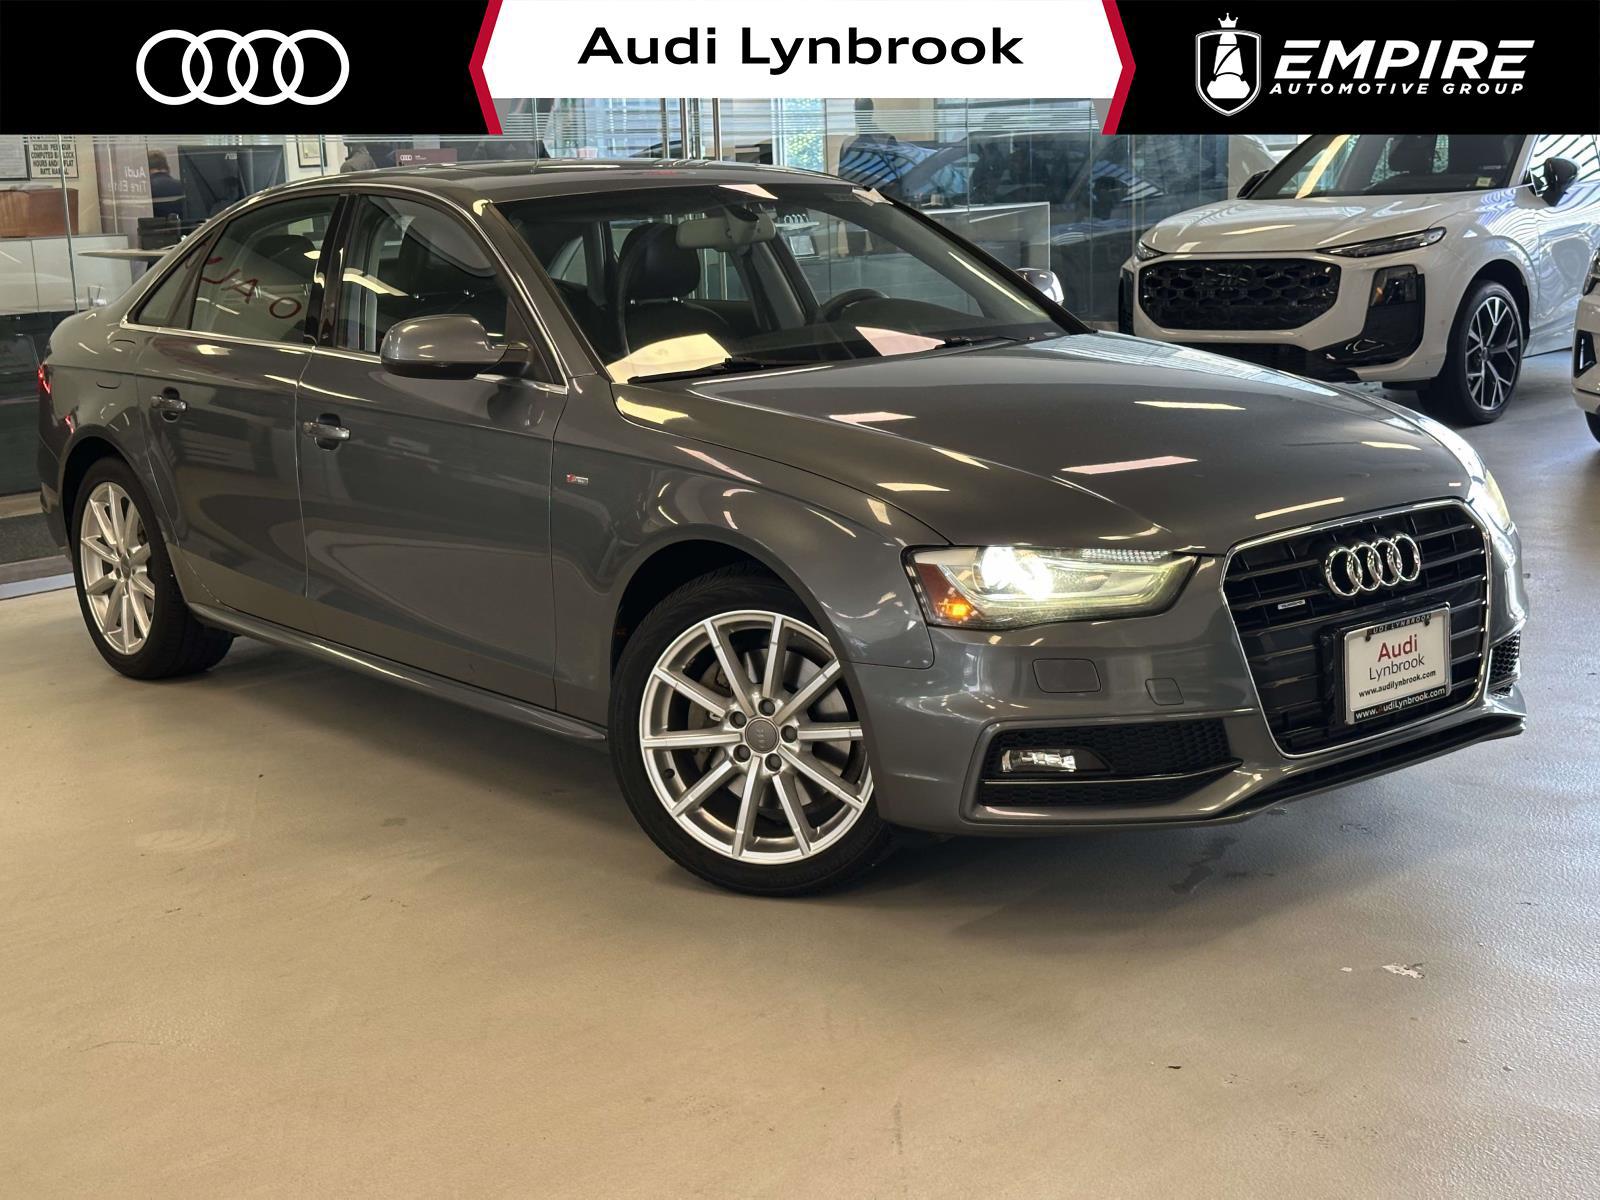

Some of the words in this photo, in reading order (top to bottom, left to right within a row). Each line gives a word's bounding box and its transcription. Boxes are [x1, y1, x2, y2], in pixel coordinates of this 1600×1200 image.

[1377, 634, 1418, 662] Audi
[1369, 653, 1425, 682] Lynbrook
[1358, 670, 1437, 698] www.audilynbrook.com
